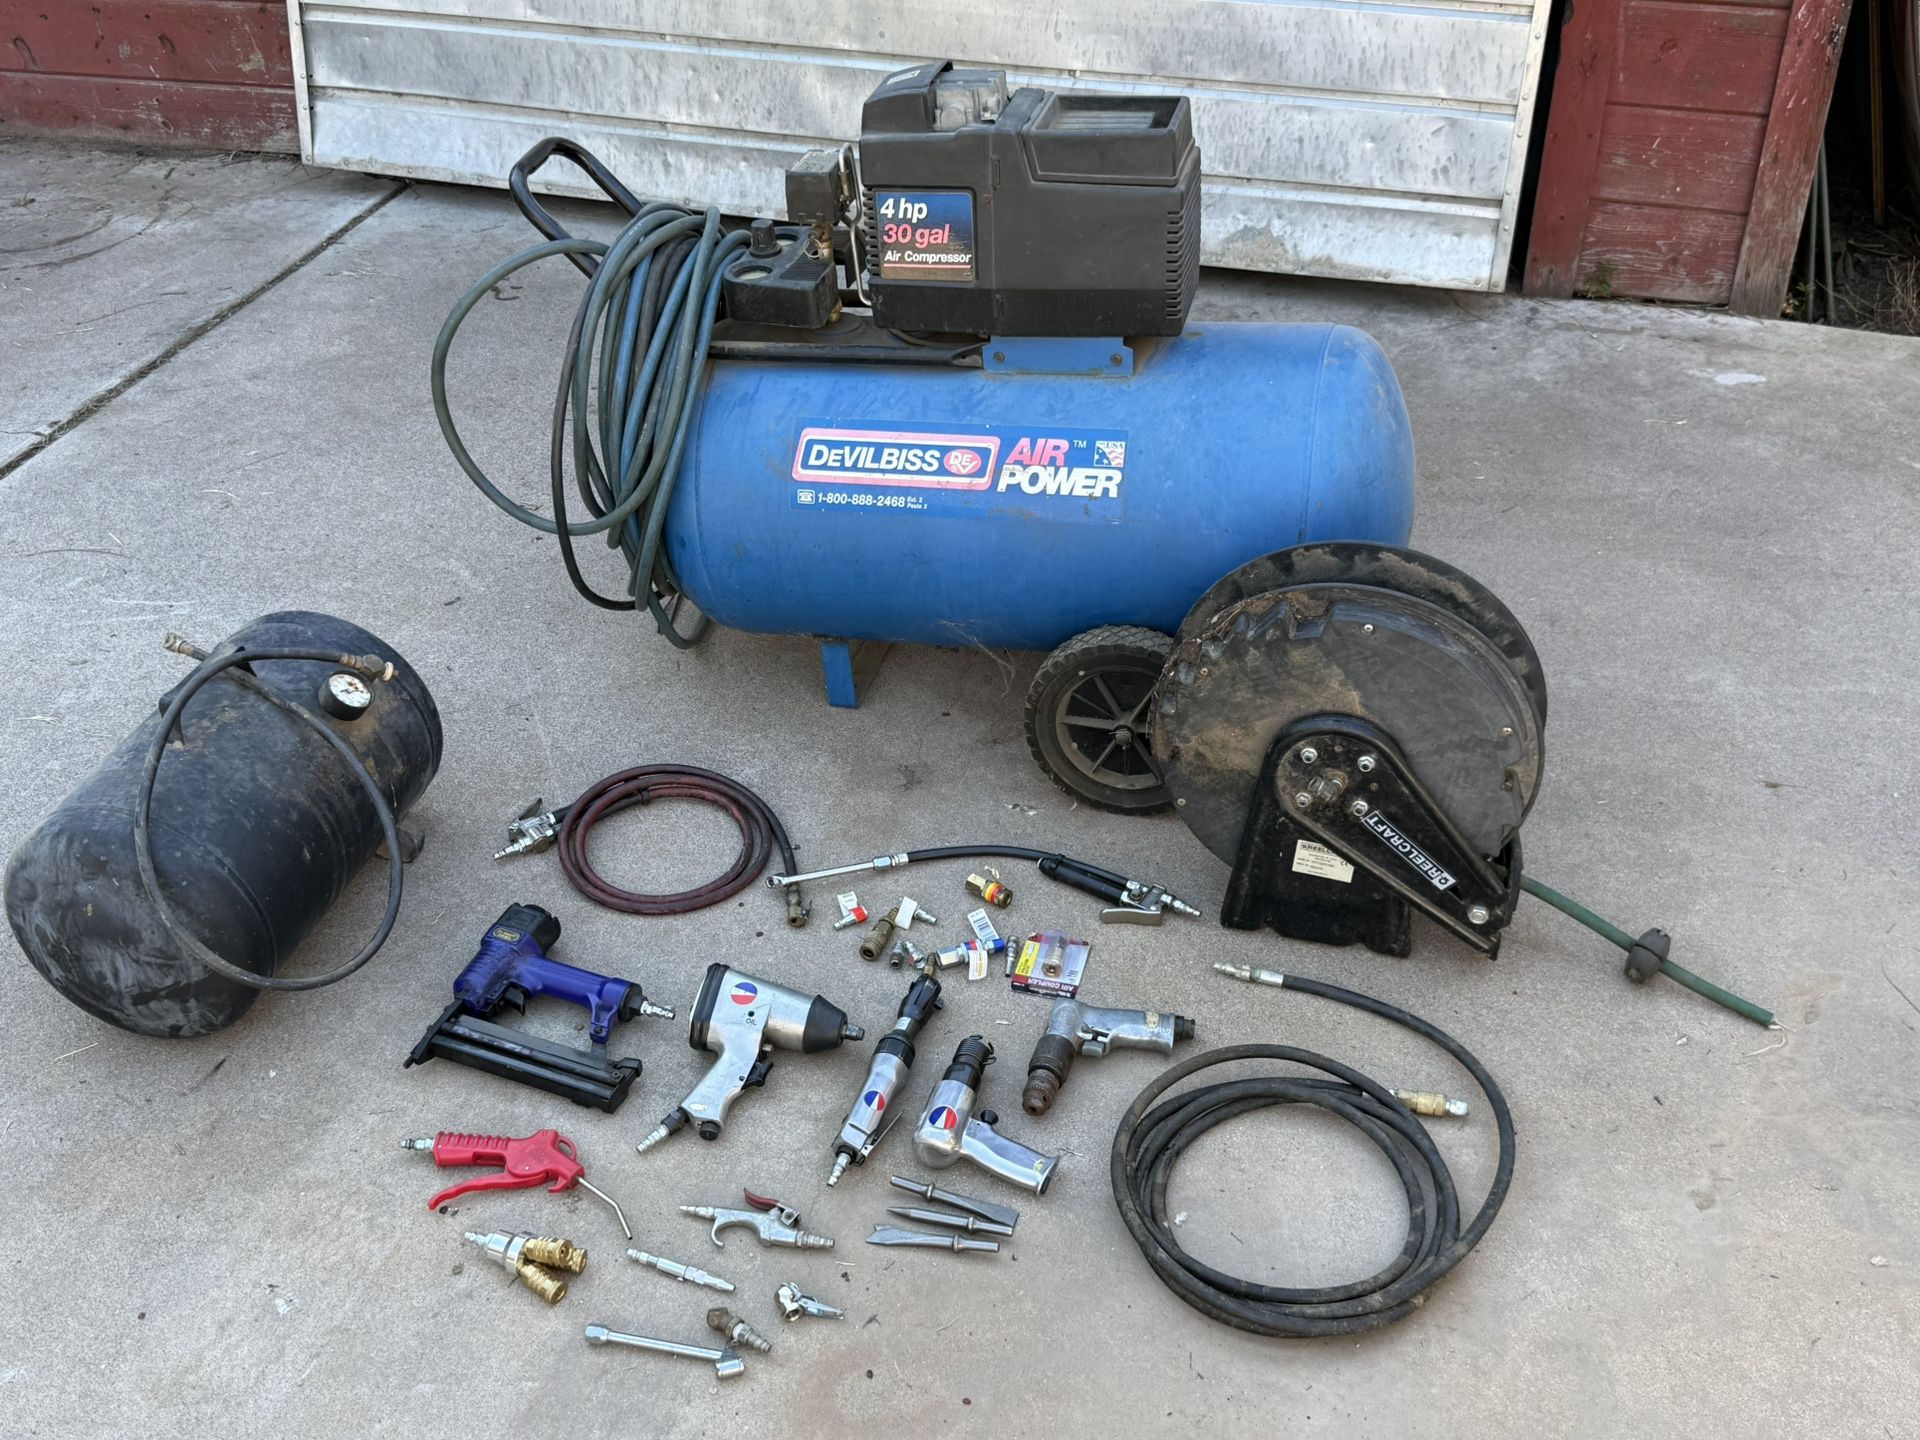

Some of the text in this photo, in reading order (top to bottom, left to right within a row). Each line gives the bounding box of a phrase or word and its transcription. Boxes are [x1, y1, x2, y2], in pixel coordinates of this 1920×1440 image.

[880, 198, 928, 223] 4 hp
[883, 224, 950, 248] 30 gal
[884, 250, 972, 264] Air Compressor
[1005, 437, 1087, 466] AIR TM
[997, 464, 1122, 498] POWER
[817, 492, 905, 507] 1-800-888-2468
[1366, 815, 1442, 880] REELCRAFT
[1028, 978, 1061, 989] COUPLER
